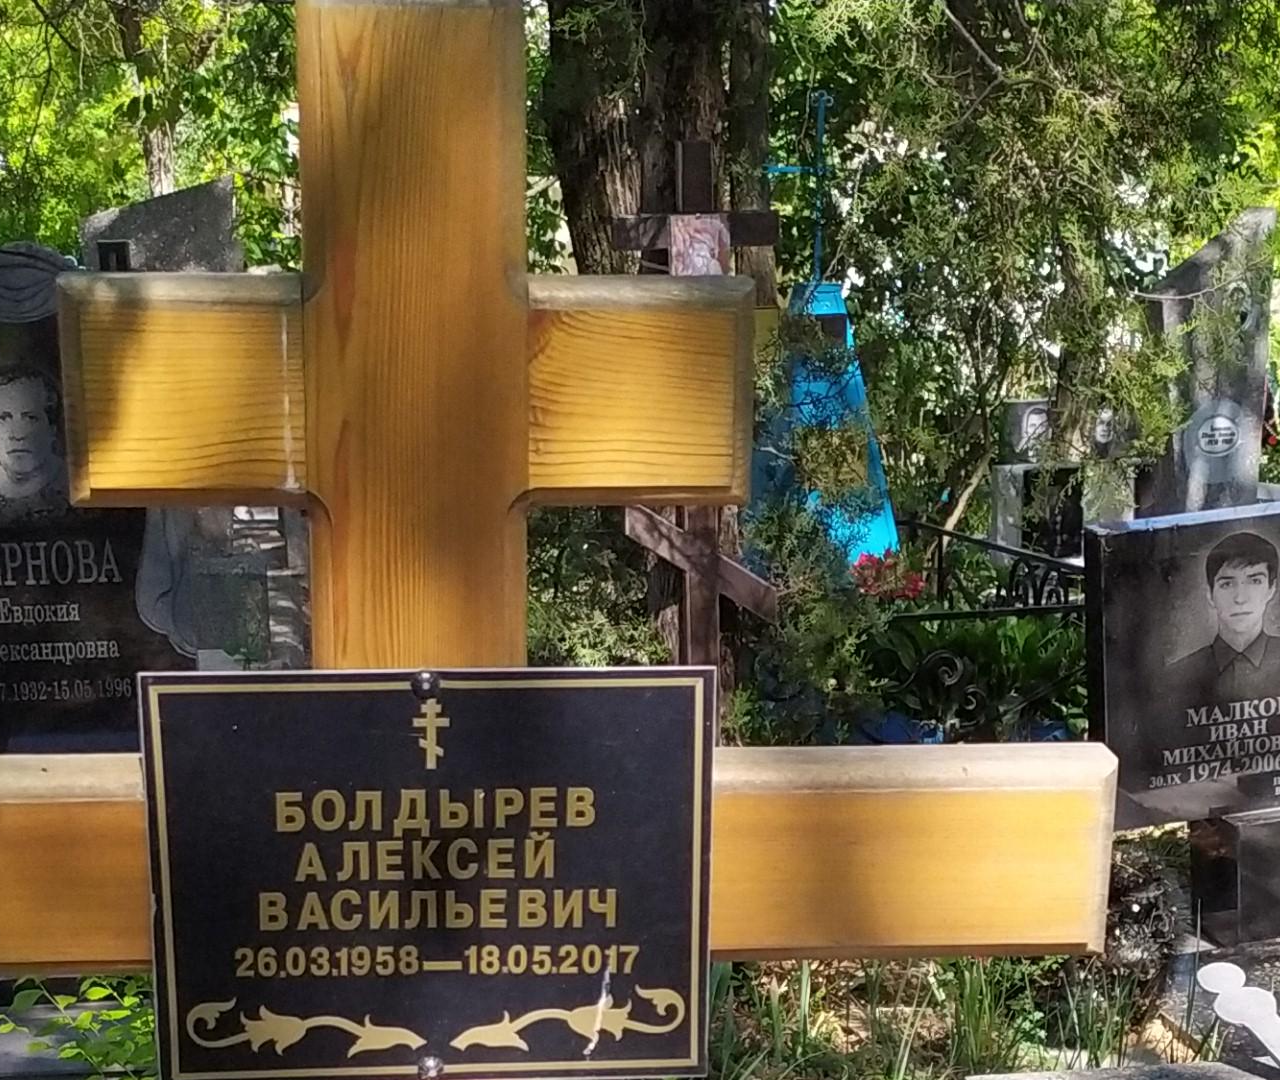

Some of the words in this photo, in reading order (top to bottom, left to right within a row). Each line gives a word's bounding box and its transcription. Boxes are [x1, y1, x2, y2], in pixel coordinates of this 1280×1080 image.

[0, 597, 81, 625] Евдокия
[1208, 718, 1269, 742] ИВАН
[274, 787, 597, 836] БОЛДЫРЕВ
[294, 831, 556, 883] АЛЕКСЕЙ
[258, 888, 618, 932] ВАСИЛЬЕВИЧ
